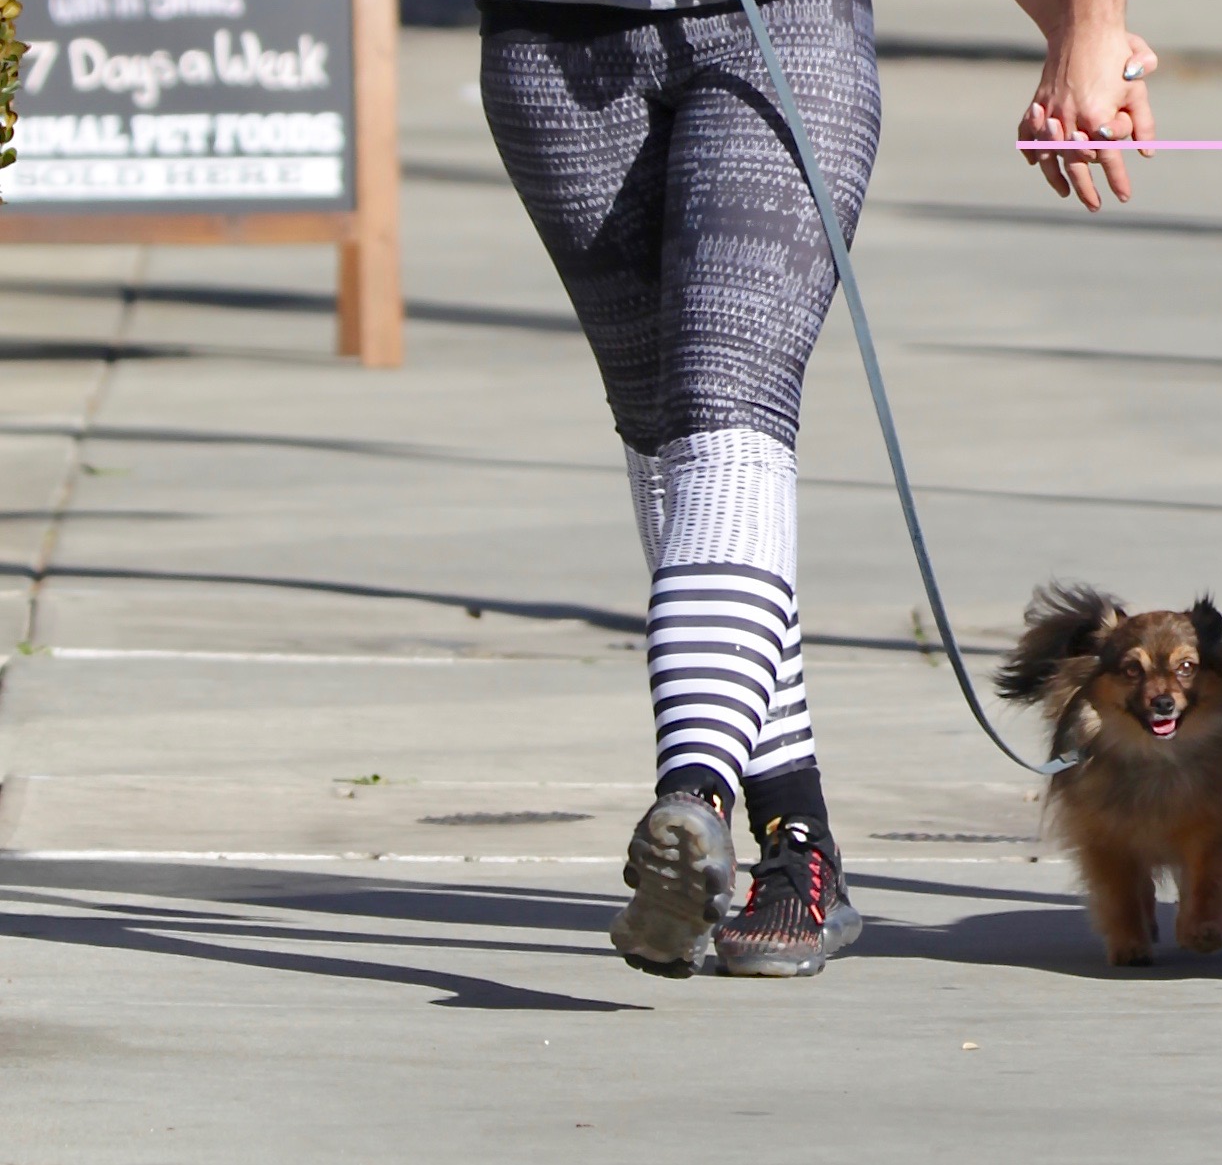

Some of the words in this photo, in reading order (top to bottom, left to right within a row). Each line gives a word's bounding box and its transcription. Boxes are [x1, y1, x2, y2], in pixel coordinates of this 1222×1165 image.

[25, 40, 58, 94] 7
[67, 37, 178, 109] Days
[179, 49, 213, 87] a
[213, 27, 330, 90] Week
[131, 114, 211, 154] PET
[213, 112, 344, 154] FOODS
[14, 160, 145, 187] SOLD
[165, 159, 303, 186] HERE
